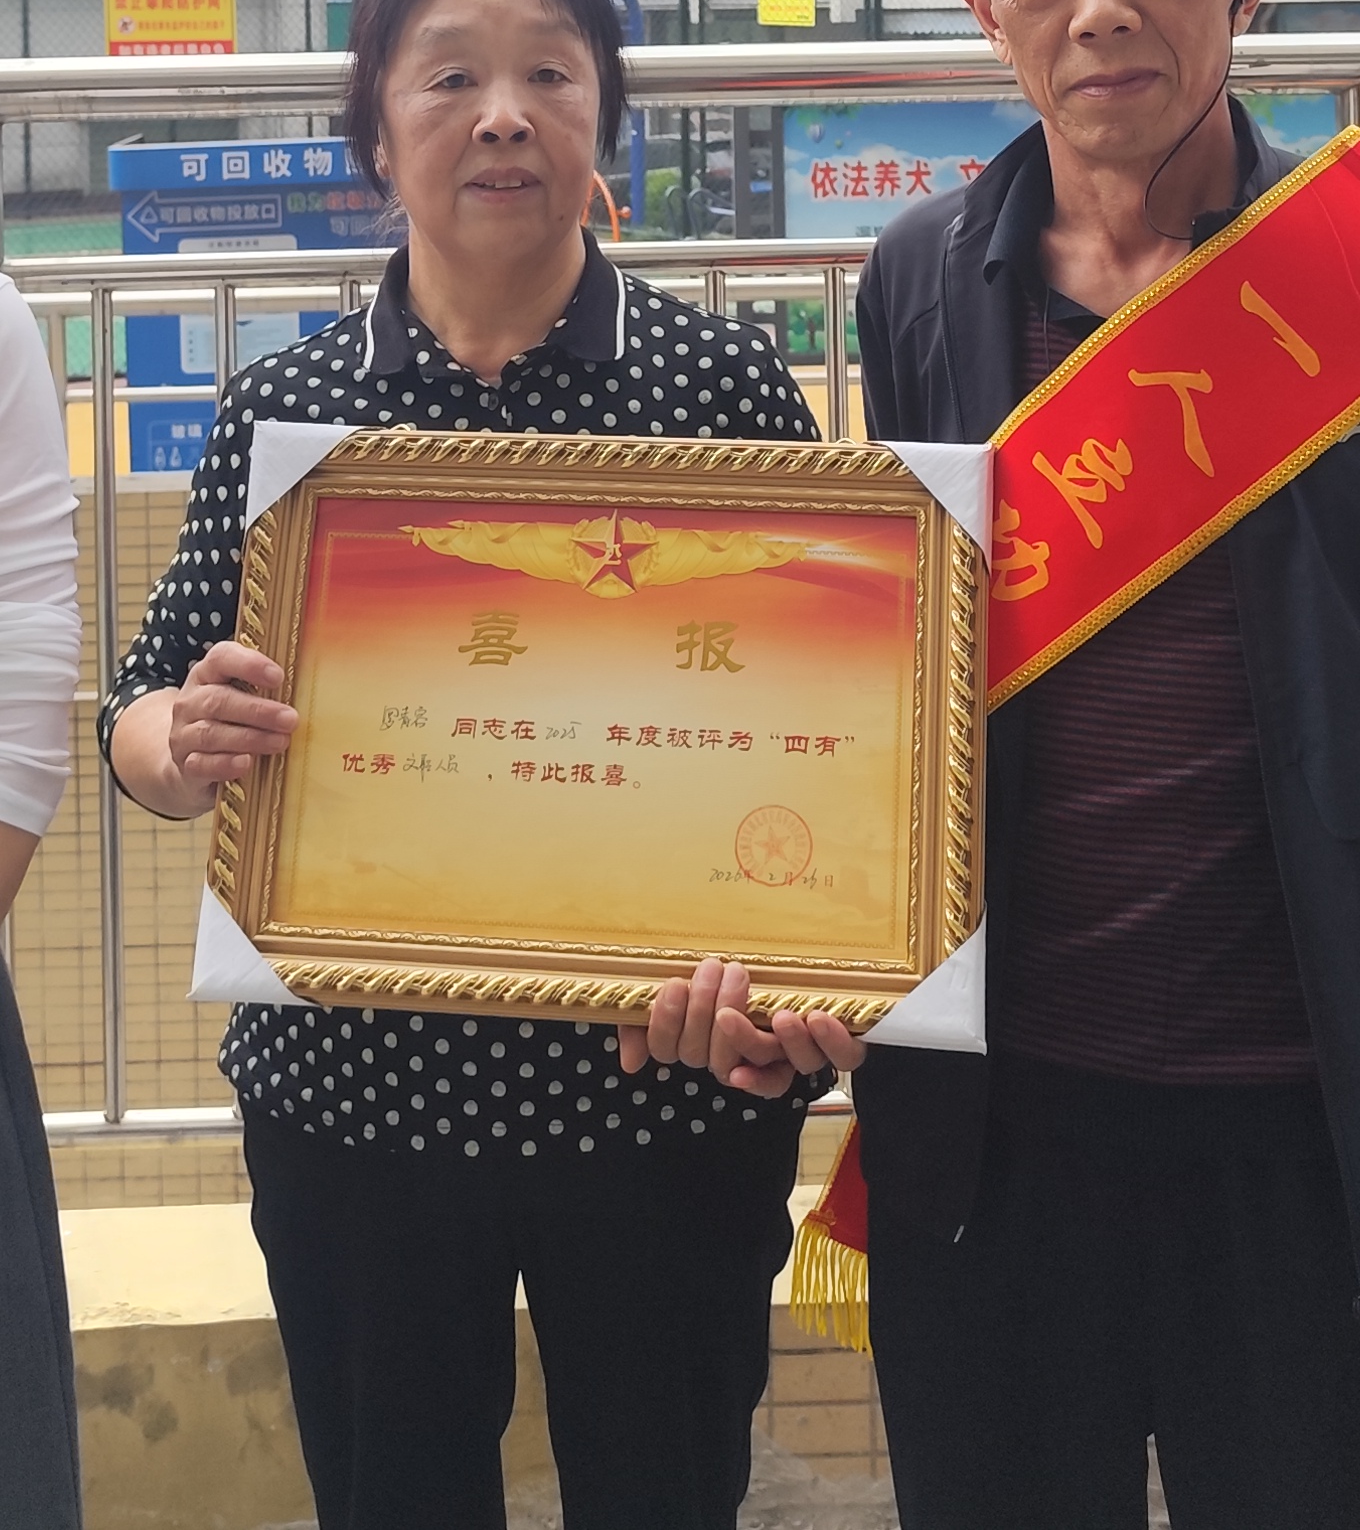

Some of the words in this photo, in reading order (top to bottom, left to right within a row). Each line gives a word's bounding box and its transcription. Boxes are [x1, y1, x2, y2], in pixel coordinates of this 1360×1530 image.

[180, 147, 360, 182] 可回收物
[811, 160, 932, 199] 依法养犬
[159, 203, 277, 225] 可回收物投放口
[458, 609, 746, 673] 喜报
[451, 717, 537, 741] 同志在
[545, 721, 582, 740] 2025
[342, 752, 397, 775] 优秀
